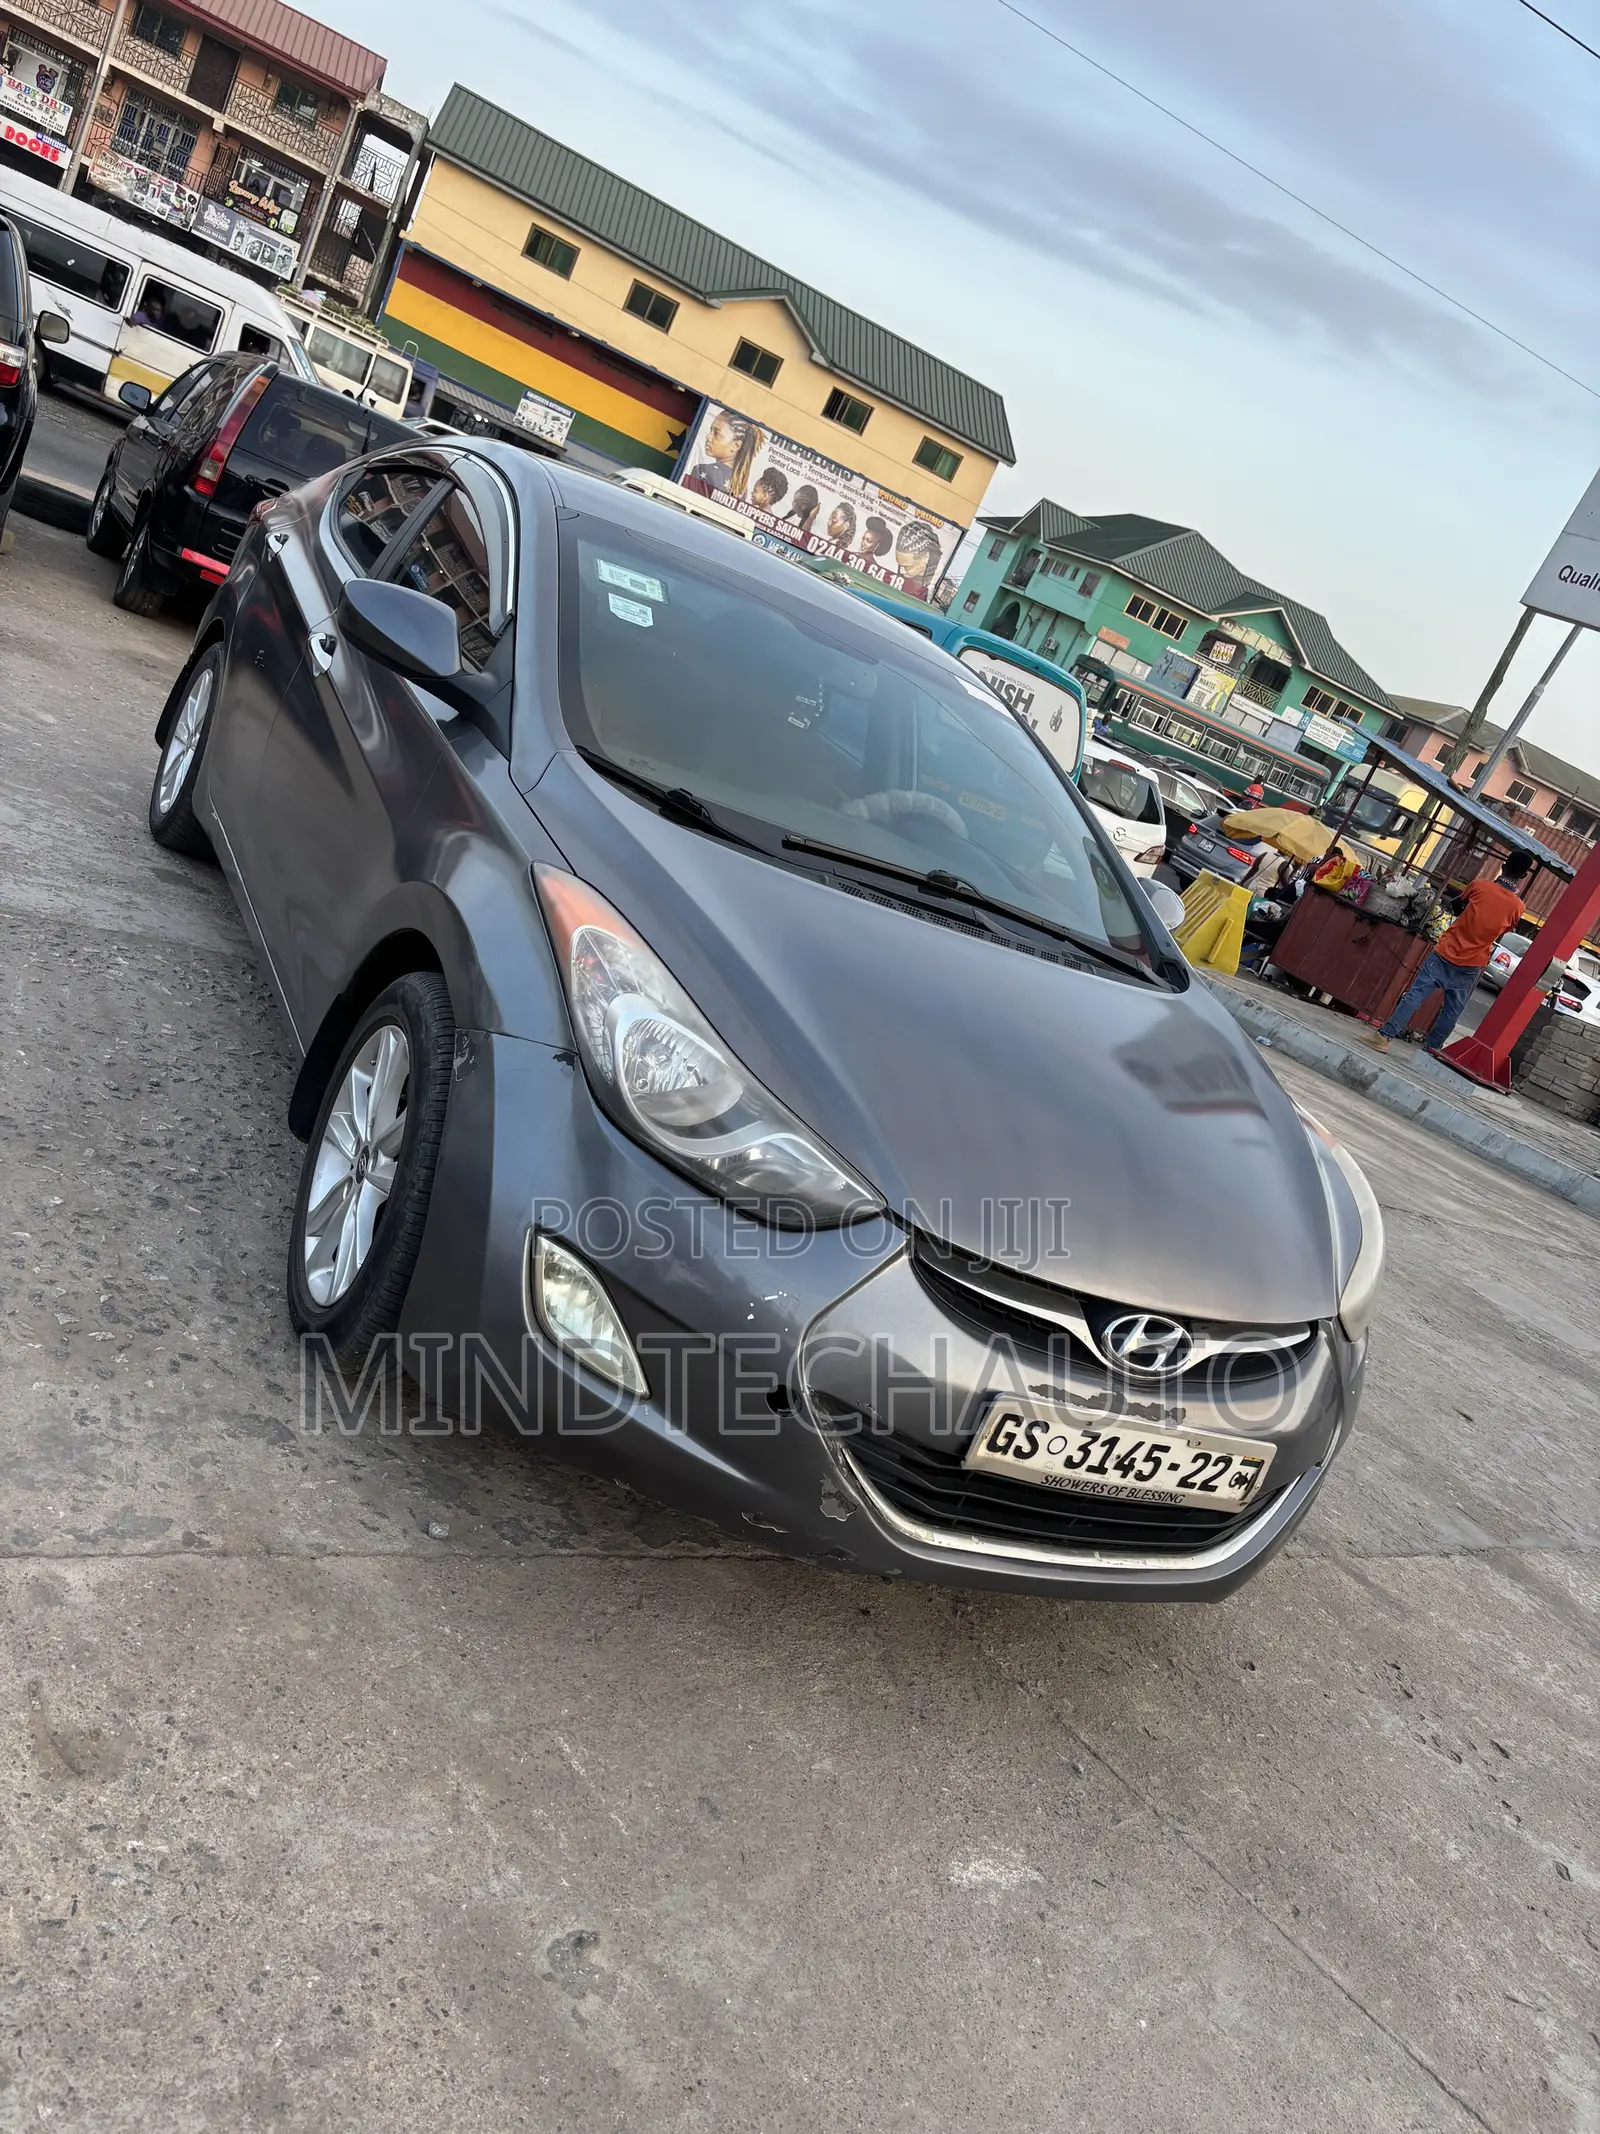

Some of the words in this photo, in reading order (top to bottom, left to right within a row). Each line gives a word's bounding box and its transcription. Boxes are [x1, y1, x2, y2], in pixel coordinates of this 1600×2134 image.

[7, 78, 40, 98] BABY
[41, 95, 71, 114] DRIP
[17, 93, 58, 117] CLOSET
[5, 125, 60, 162] DOORS
[768, 455, 786, 469] Sister
[786, 464, 801, 476] Locs
[768, 446, 803, 469] Permanent
[807, 465, 838, 485] Temporal
[842, 482, 877, 504] Interlocking
[878, 500, 908, 520] Treatment
[710, 488, 738, 509] MULTI
[736, 502, 777, 528] CLIPPERS
[775, 519, 804, 541] SALON
[878, 489, 909, 511] PROMO
[915, 507, 944, 529] PROMO
[806, 535, 845, 562] 0244
[846, 554, 867, 572] 30
[867, 563, 887, 582] 64
[887, 574, 905, 591] 18
[986, 1413, 1050, 1460] GS
[1065, 1430, 1234, 1492] 3145-22
[1041, 1475, 1107, 1495] SHOWERS
[1108, 1484, 1126, 1497] OF
[1128, 1486, 1187, 1504] BLESSING
